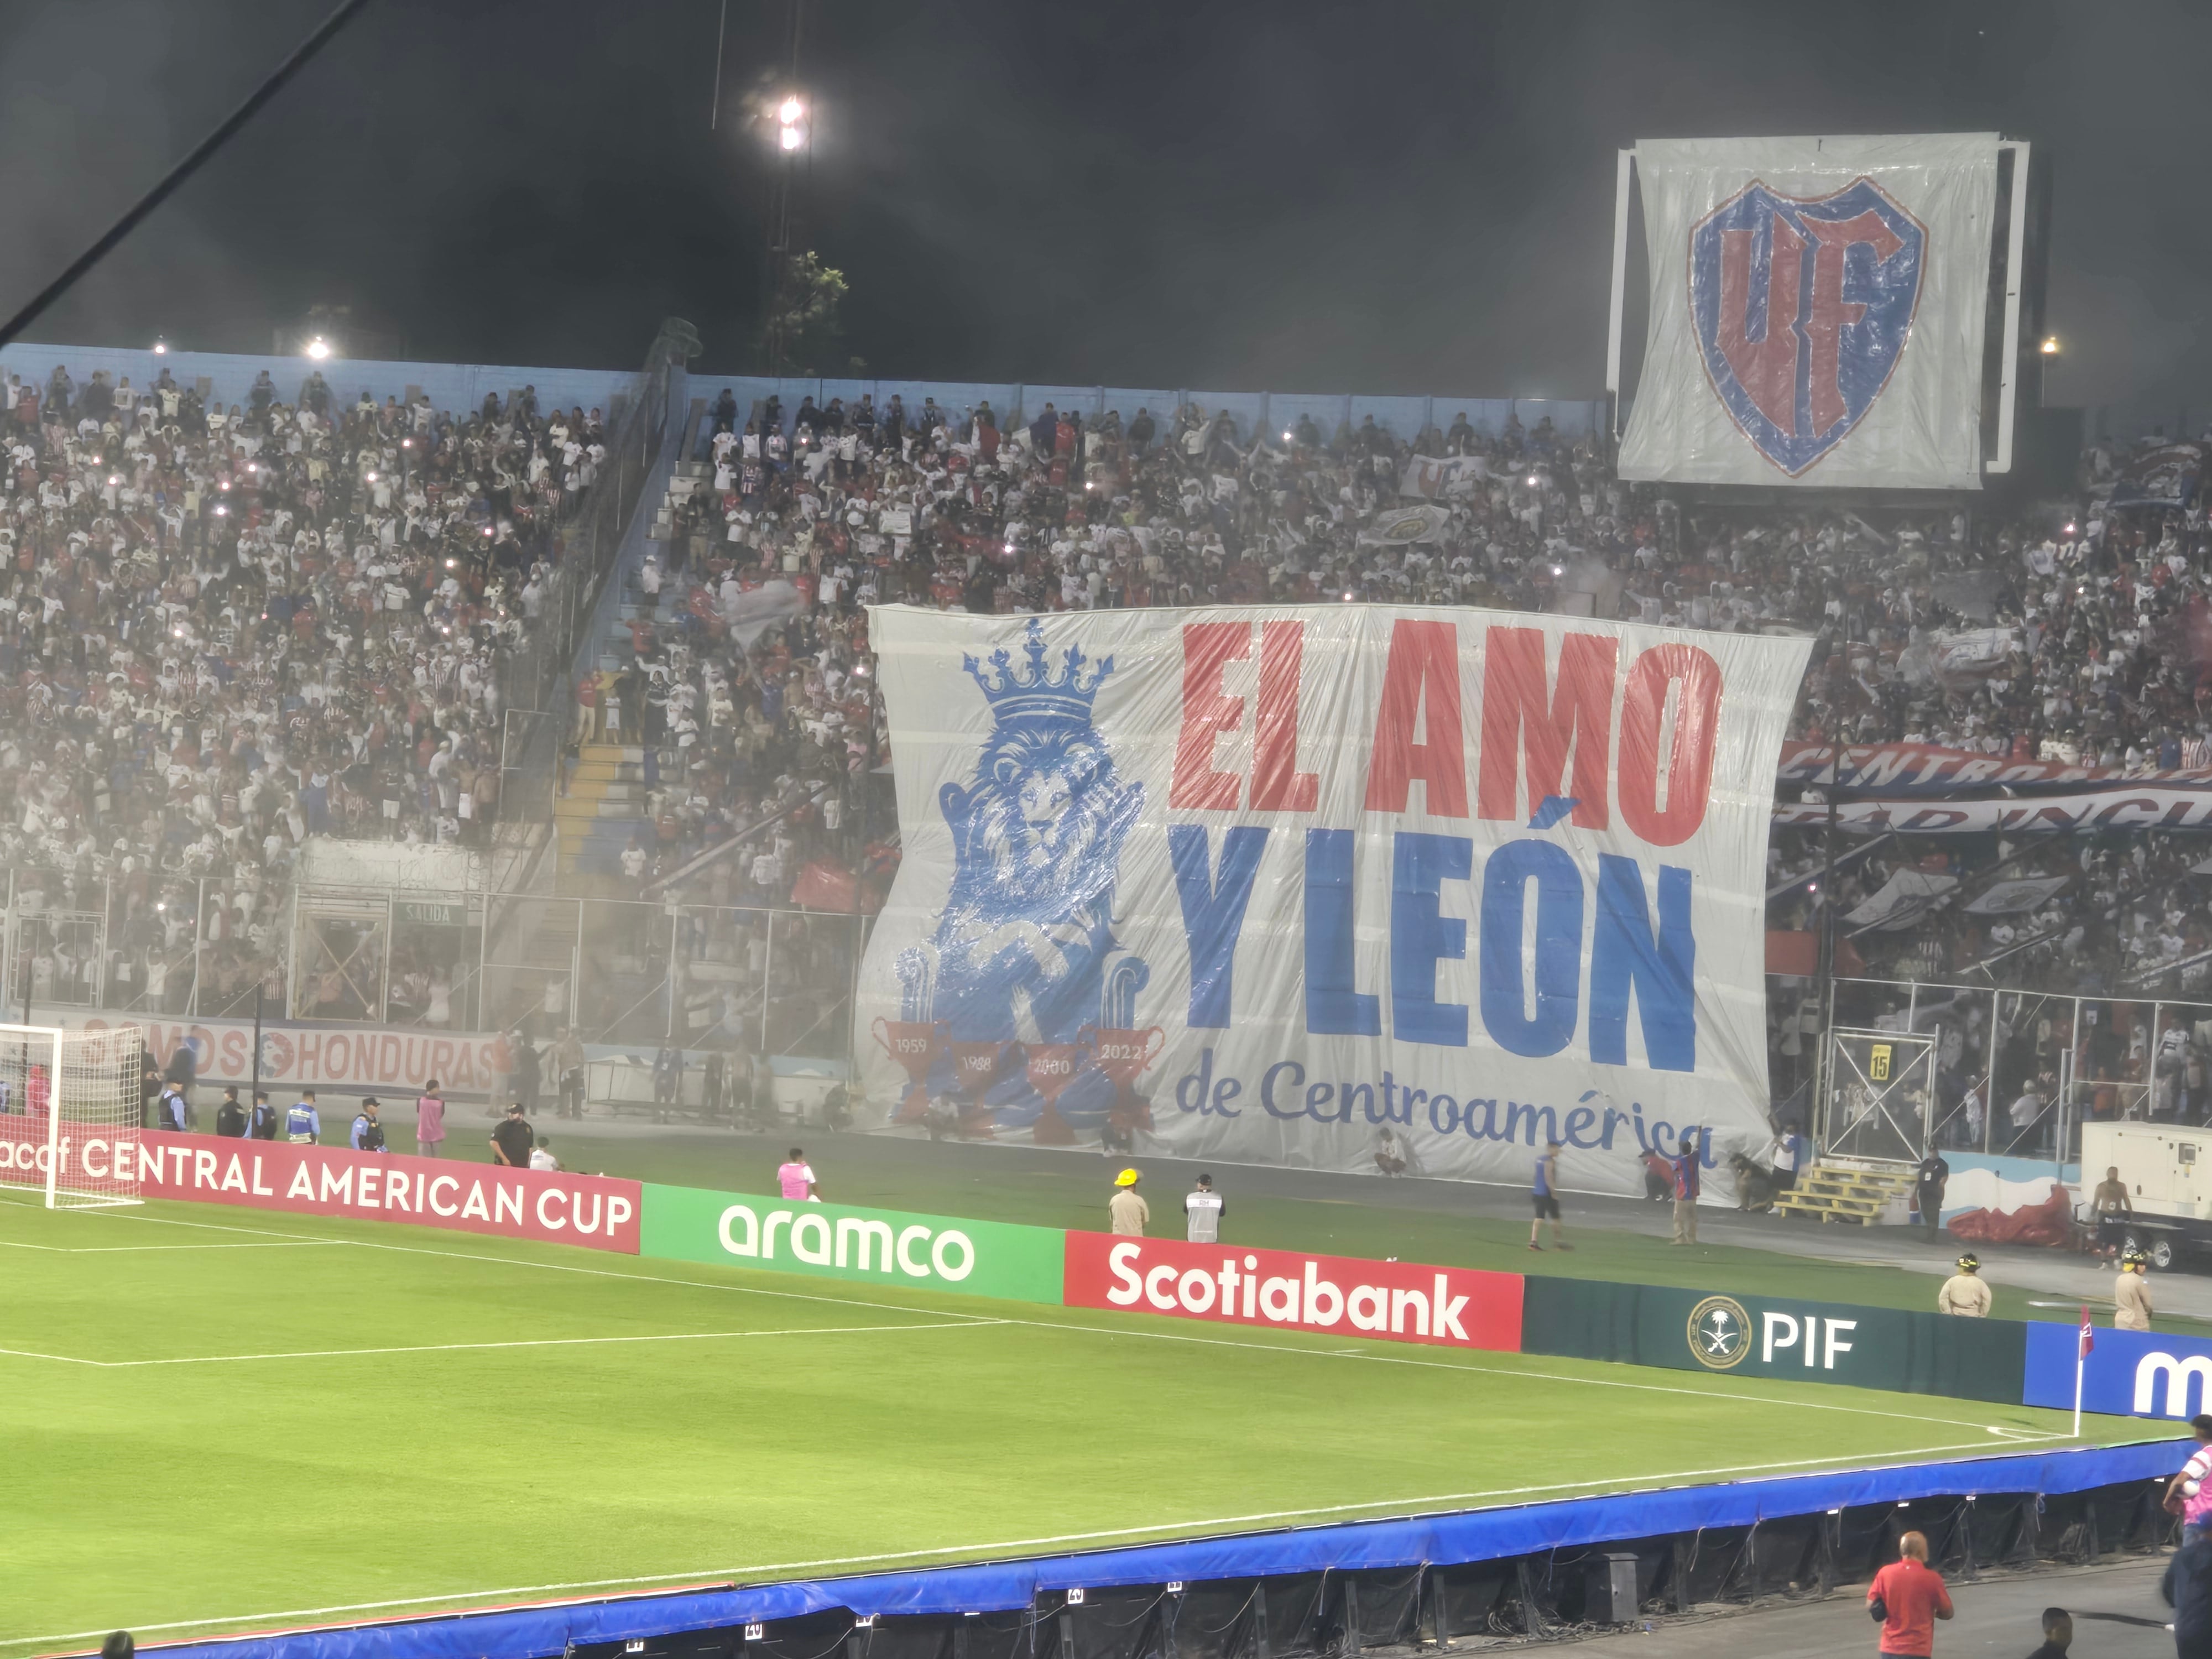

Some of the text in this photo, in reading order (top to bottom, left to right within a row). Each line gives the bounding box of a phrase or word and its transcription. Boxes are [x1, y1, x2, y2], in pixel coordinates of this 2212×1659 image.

[1168, 618, 1724, 847] EL AMO
[406, 905, 450, 922] SALIDA
[1167, 794, 1696, 1073] Y LEÓN
[296, 1032, 495, 1089] HONDURAS
[895, 1038, 927, 1053] 1959
[1100, 1044, 1142, 1061] 2022
[1873, 1056, 1887, 1077] 15
[1176, 1048, 1718, 1170] de Centroamérica
[82, 1139, 273, 1196] CENTRAL
[286, 1160, 524, 1226] AMERICAN
[536, 1188, 632, 1236] CUP
[718, 1204, 974, 1281] aramco
[1107, 1242, 1470, 1340] Scotiabank
[1762, 1311, 1858, 1369] PIF
